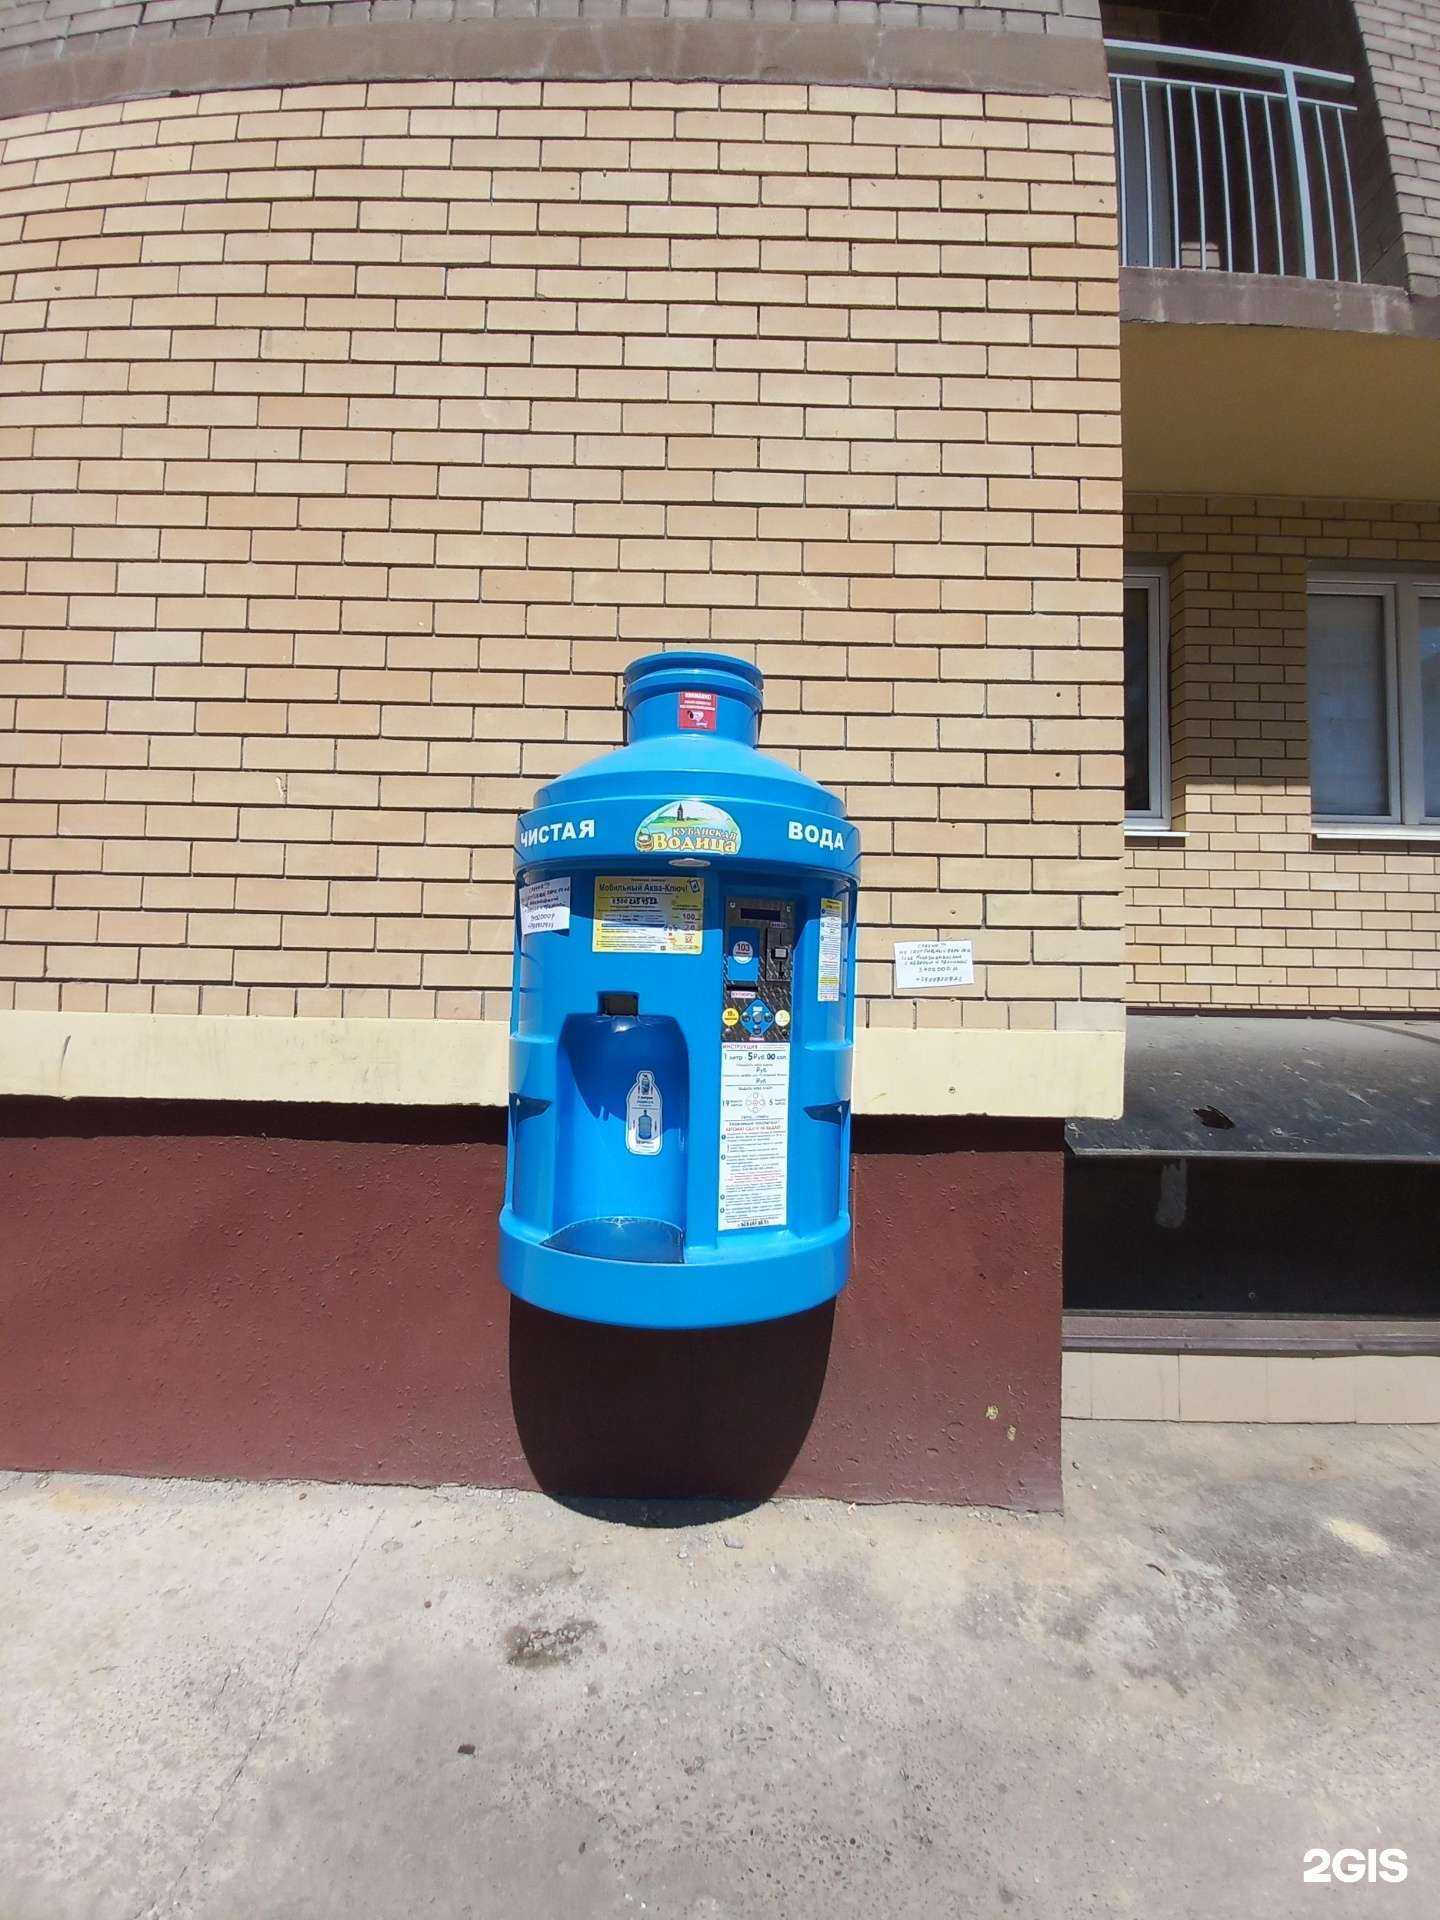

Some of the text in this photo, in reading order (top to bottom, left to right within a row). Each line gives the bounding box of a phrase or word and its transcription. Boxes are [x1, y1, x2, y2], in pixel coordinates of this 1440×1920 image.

[520, 819, 595, 848] ЧИСТАЯ
[788, 822, 846, 850] ВОДА
[682, 913, 696, 921] 100
